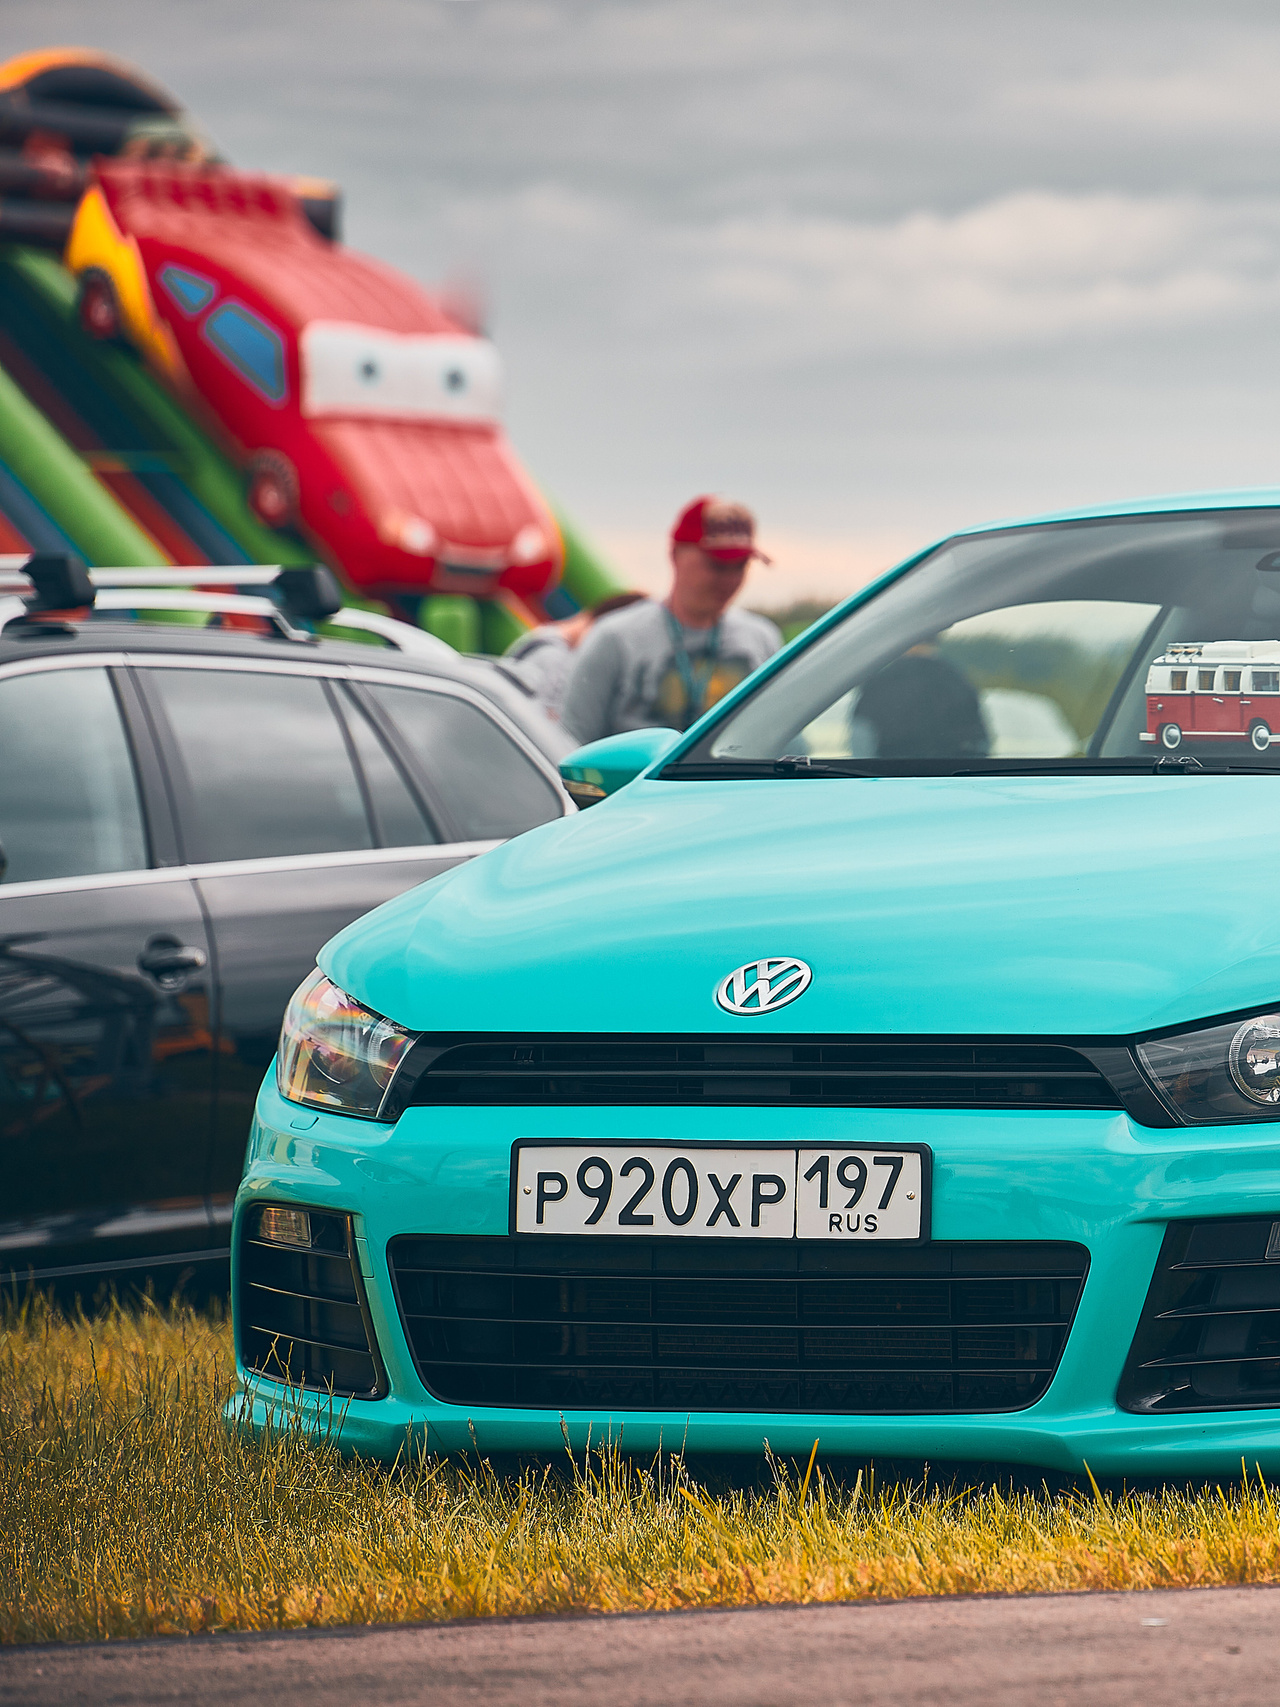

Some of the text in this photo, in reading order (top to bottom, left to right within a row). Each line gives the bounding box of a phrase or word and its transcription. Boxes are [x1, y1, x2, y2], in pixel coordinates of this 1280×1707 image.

[535, 1155, 904, 1228] P920XP 197
[828, 1212, 879, 1233] RUS
